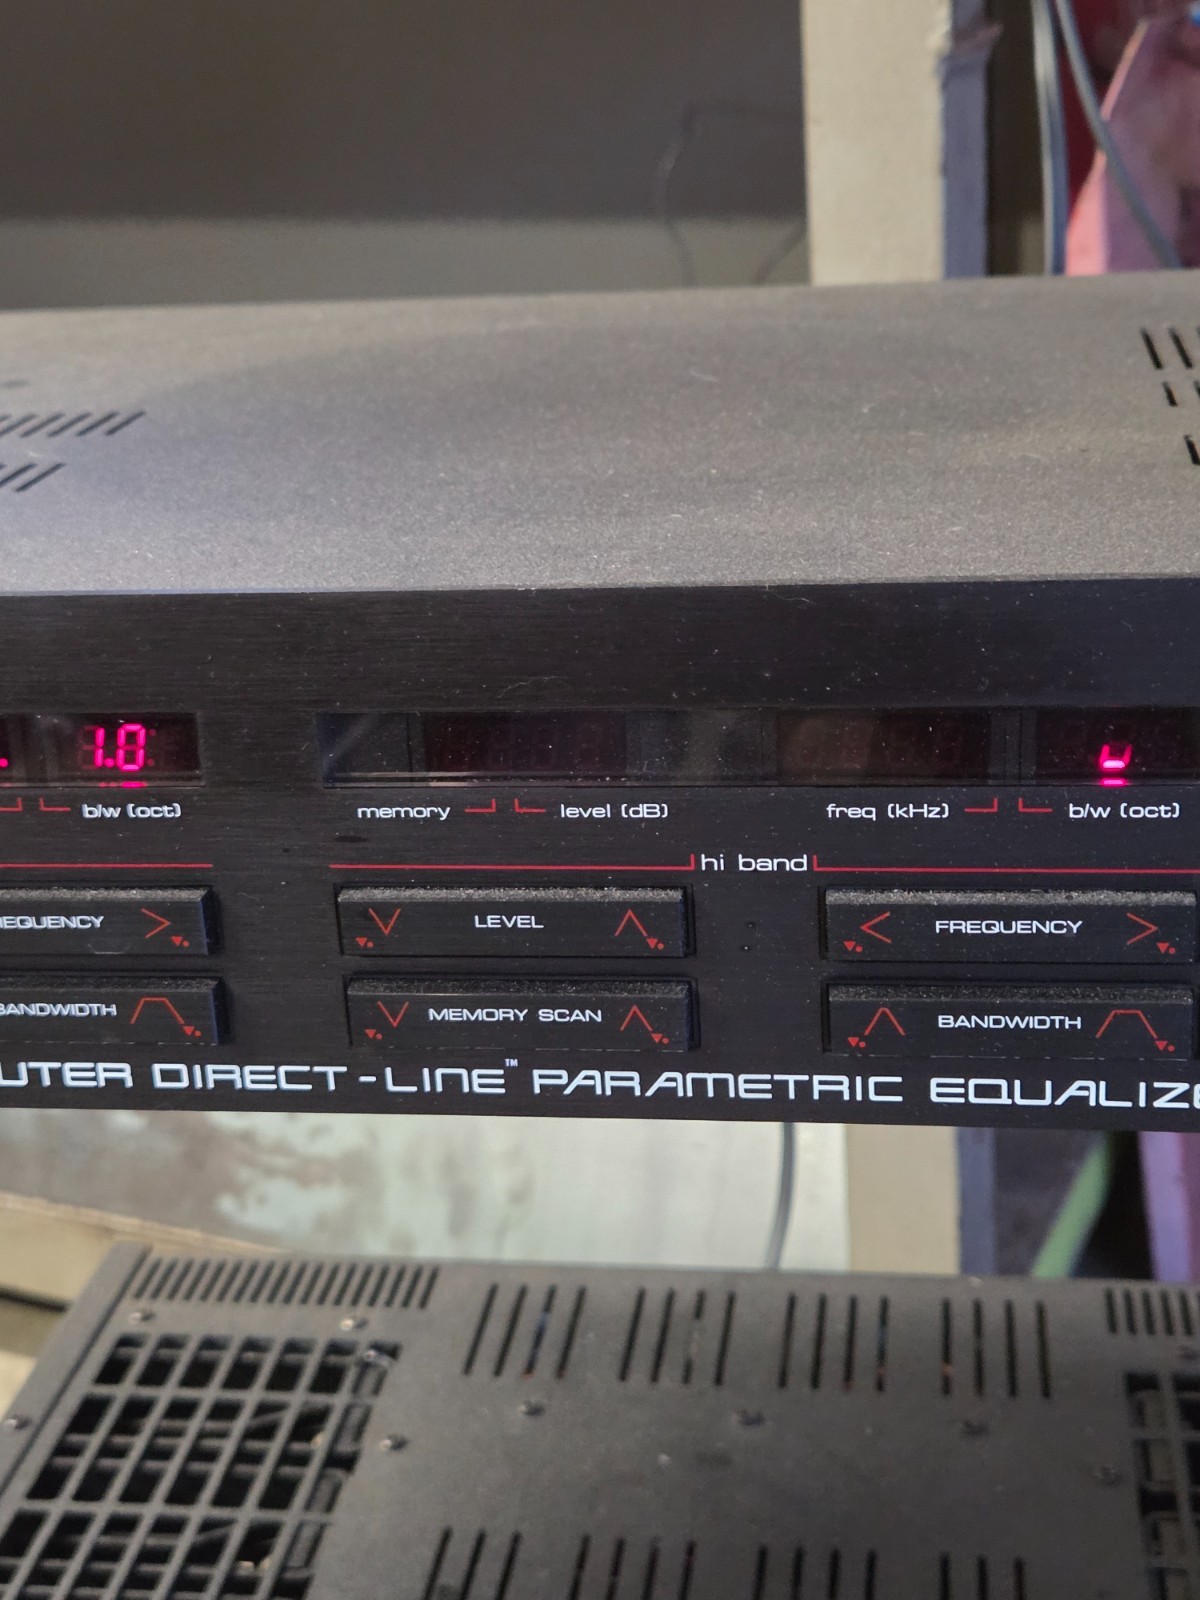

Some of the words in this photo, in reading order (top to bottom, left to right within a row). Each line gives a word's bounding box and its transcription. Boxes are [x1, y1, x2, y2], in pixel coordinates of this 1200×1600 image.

[94, 723, 146, 772] 1.0
[82, 803, 121, 818] b/w
[126, 803, 182, 818] (oct)
[357, 806, 451, 821] memory
[560, 803, 611, 818] level
[620, 803, 669, 818] (dB)
[825, 803, 877, 821] freq
[887, 803, 949, 818] (kHz)
[1068, 803, 1112, 818] b/w
[1119, 803, 1180, 818] (oct)
[701, 853, 725, 871] hi
[738, 853, 808, 871] band
[0, 915, 105, 929] EQUENCY
[474, 915, 545, 929] LEVEL
[935, 920, 1083, 934] FREQUENCY
[428, 1008, 529, 1022] MEMORY
[537, 1009, 602, 1023] SCAN
[937, 1014, 1082, 1030] BANDWIDTH
[0, 1061, 134, 1088] UTER
[532, 1069, 904, 1102] PARAMETRIC
[929, 1077, 1200, 1109] EQUALIZ
